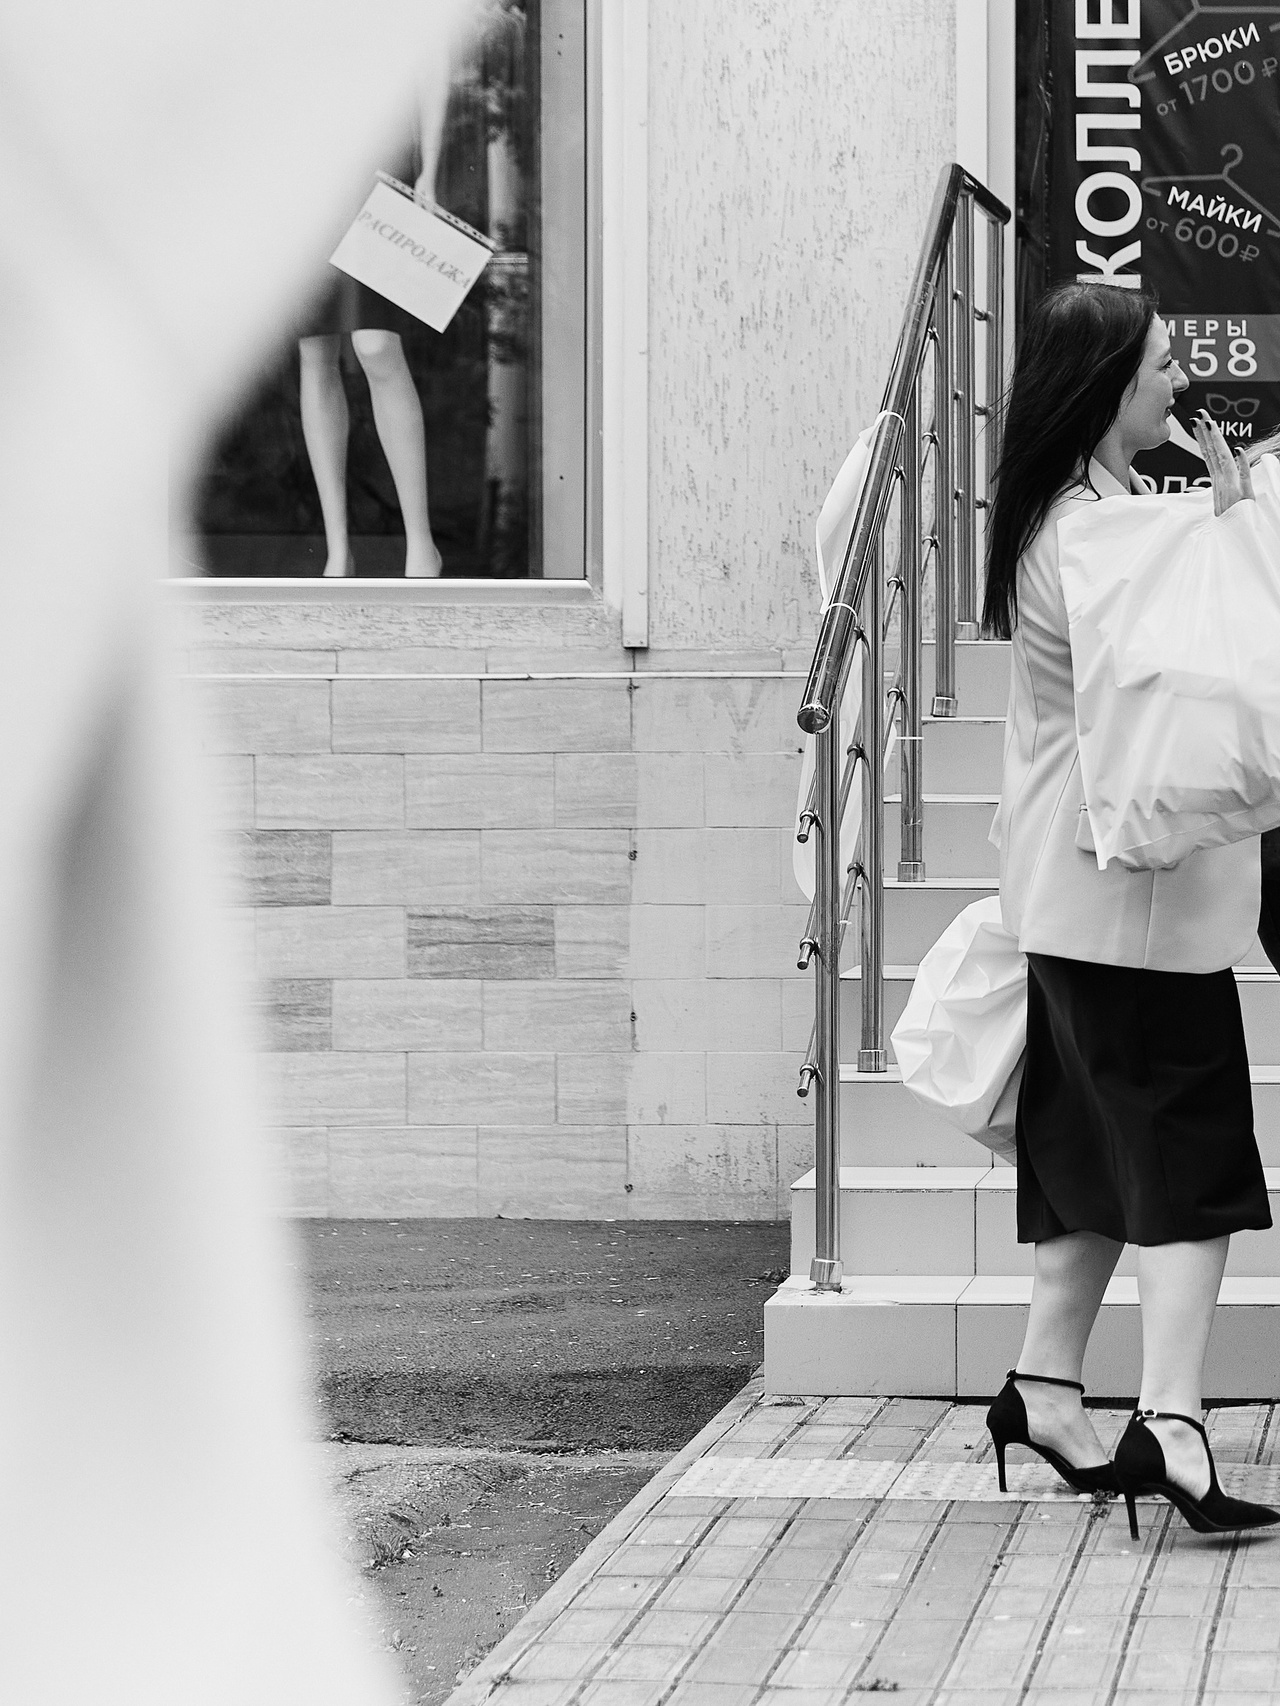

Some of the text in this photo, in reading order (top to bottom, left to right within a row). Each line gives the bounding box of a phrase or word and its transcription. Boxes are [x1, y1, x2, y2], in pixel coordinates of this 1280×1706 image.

[1163, 22, 1261, 76] БРЮКИ
[1156, 99, 1177, 116] от
[1146, 217, 1169, 233] от
[1167, 185, 1262, 233] МАЙКИ
[358, 210, 473, 289] РАСПРОДАЖА
[1174, 338, 1258, 377] 58
